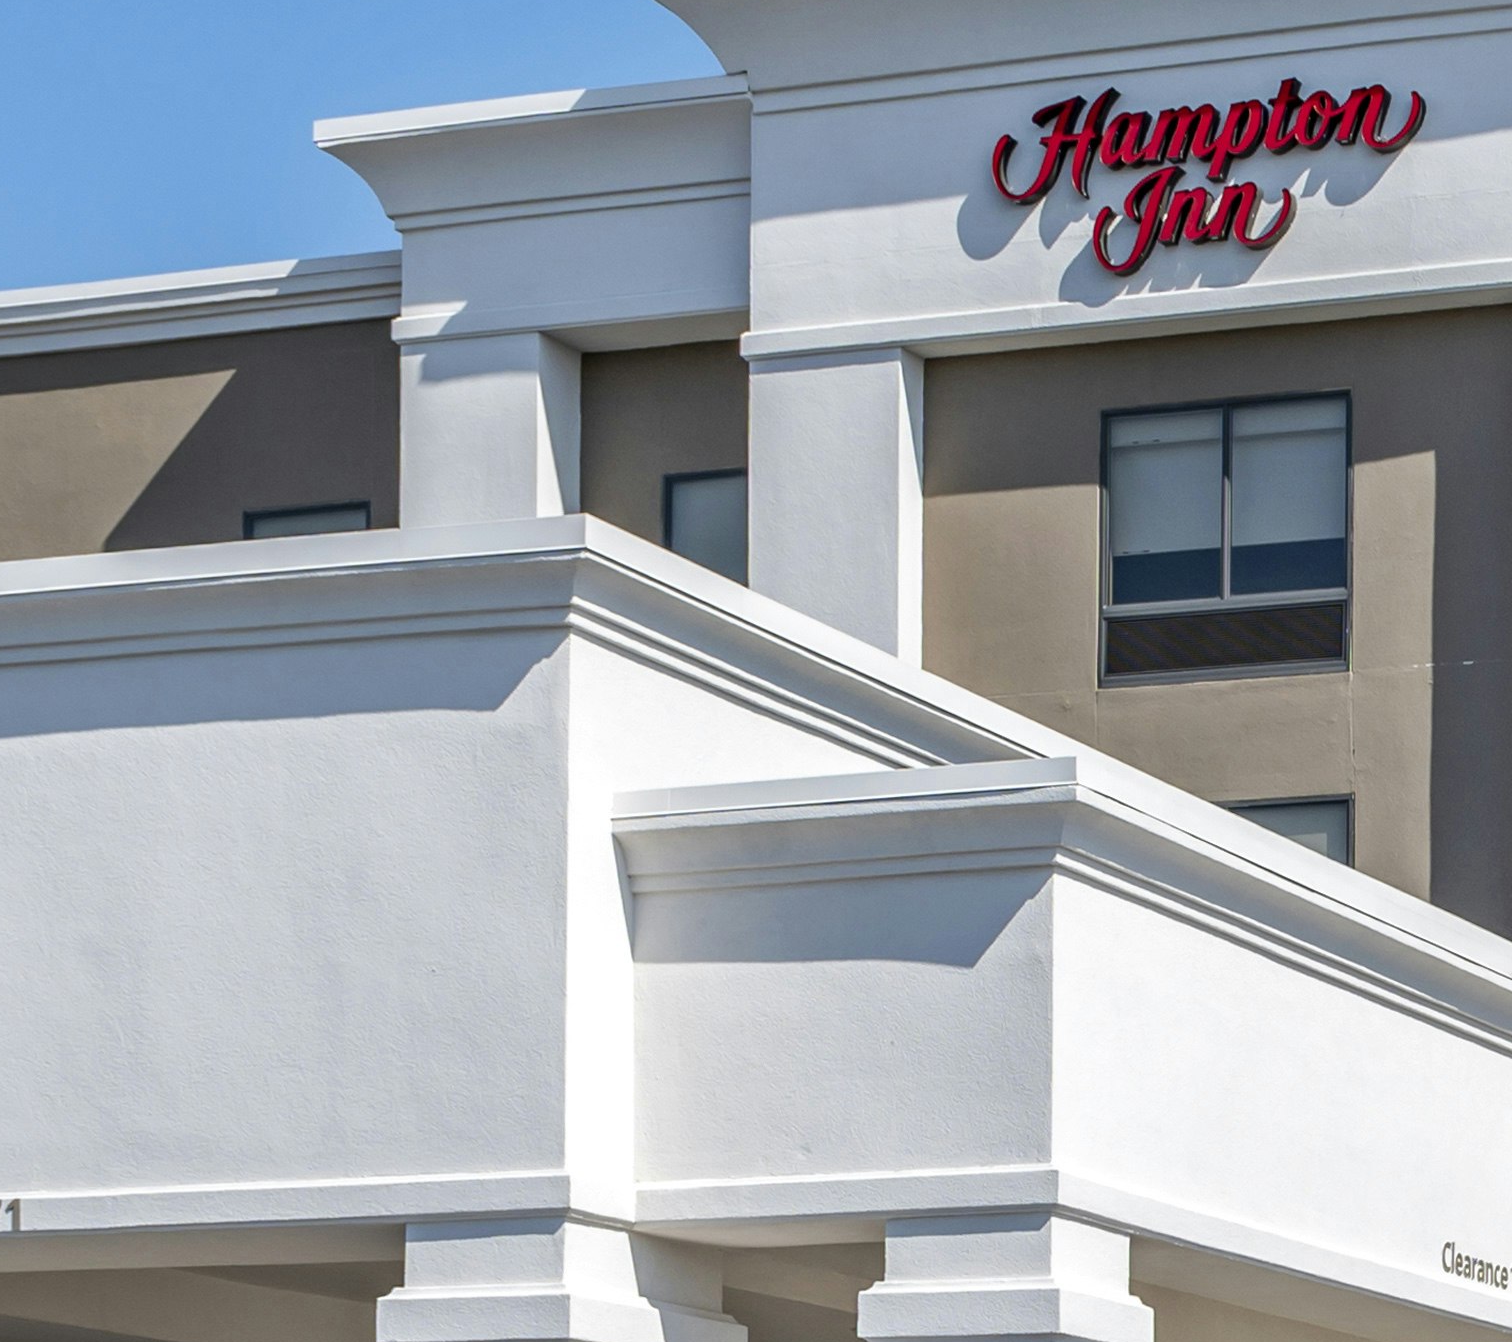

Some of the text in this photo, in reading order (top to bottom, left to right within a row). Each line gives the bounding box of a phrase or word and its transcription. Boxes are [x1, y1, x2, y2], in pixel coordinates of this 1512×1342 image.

[992, 77, 1426, 206] Hampton
[1093, 165, 1296, 276] Inn
[1441, 1241, 1509, 1290] Clearance
